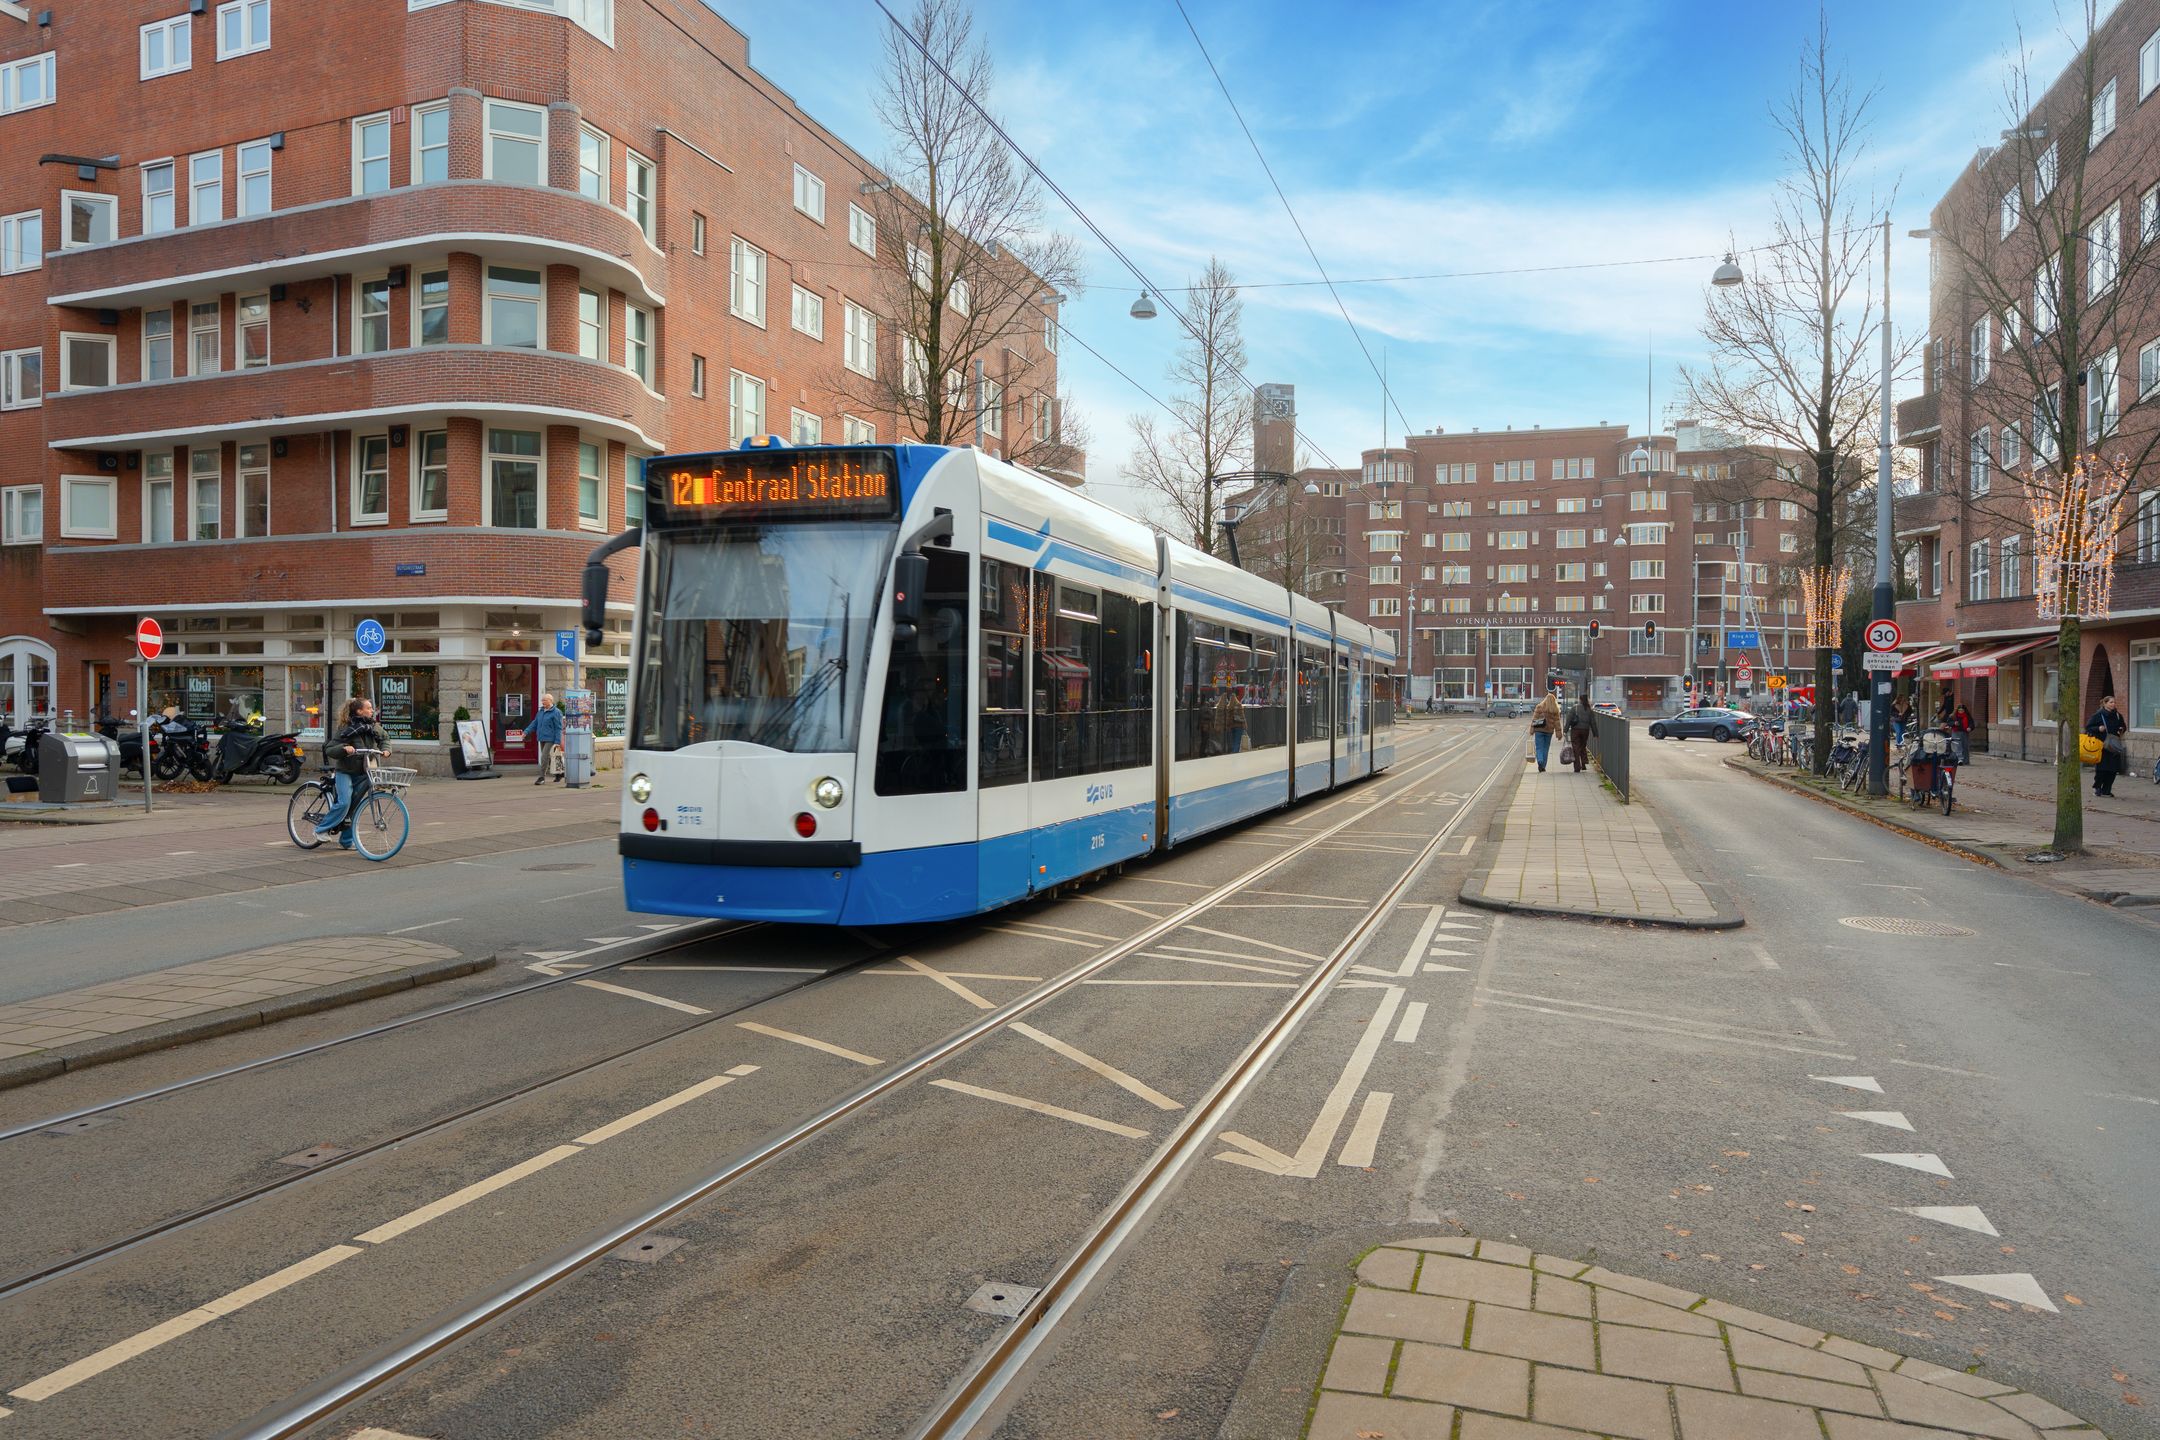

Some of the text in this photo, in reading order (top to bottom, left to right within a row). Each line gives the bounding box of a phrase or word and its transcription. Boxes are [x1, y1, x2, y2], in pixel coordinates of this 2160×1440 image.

[671, 463, 887, 505] 12 Centraal Station
[1455, 616, 1573, 625] OPENBARE BIBLIOTHEEK
[1872, 630, 1896, 642] 30
[189, 678, 211, 692] Kbal
[382, 678, 408, 693] Kbal
[607, 680, 628, 694] Kbal
[1100, 784, 1113, 799] GVB
[678, 815, 702, 825] 2115
[1091, 834, 1105, 850] 2115
